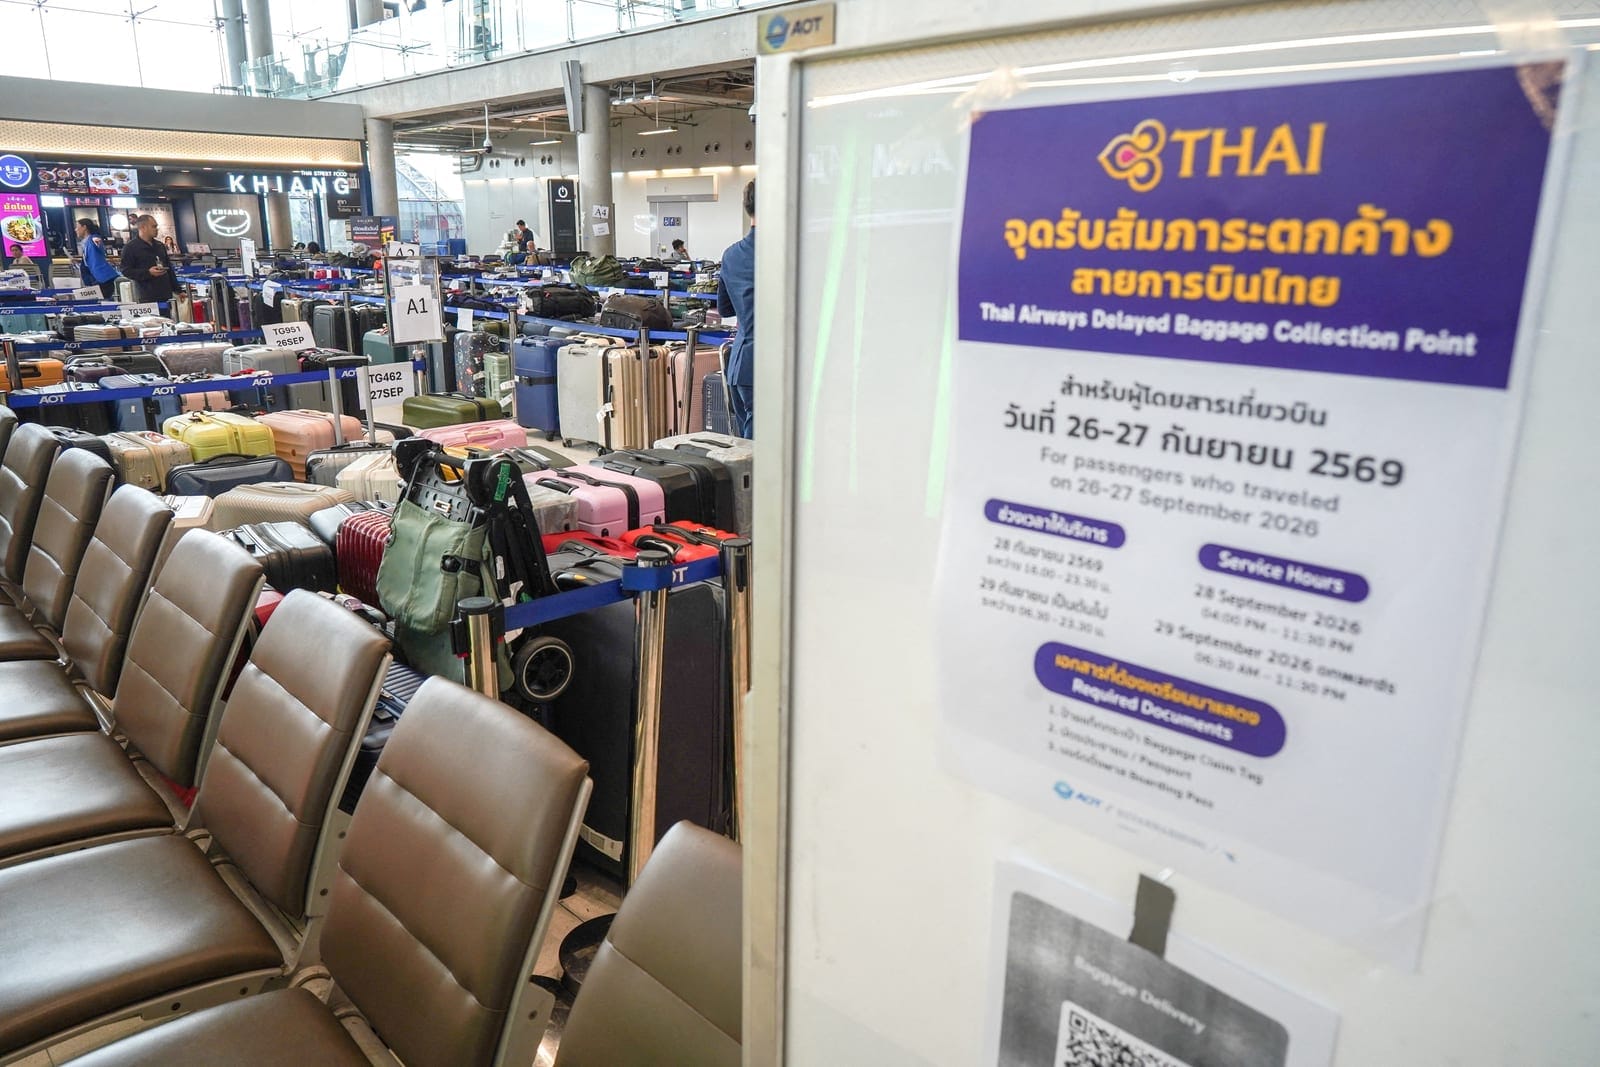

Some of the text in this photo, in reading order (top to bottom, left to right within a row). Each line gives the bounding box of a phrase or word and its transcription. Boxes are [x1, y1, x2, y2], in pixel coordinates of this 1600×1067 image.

[791, 16, 823, 36] AOT
[1169, 122, 1327, 179] THAI
[229, 174, 350, 194] KHIANG
[212, 208, 245, 216] KHIANG
[1004, 204, 1453, 260] จุดรับสัมภาระตกค้าง
[407, 298, 428, 315] A1
[1070, 265, 1340, 307] สายการบินไทย
[272, 326, 301, 336] TG951
[276, 336, 305, 347] 26SEP
[980, 302, 1478, 357] Thai Airways Delayed Baggage Collection Point
[152, 386, 177, 395] AOT
[252, 377, 274, 386] AOT
[341, 369, 356, 378] AO
[369, 371, 402, 384] TG462
[370, 386, 404, 400] 27SEP
[39, 394, 66, 404] AOT
[1060, 375, 1327, 428] สำหรับผู้โดยสารเที่ยวบิน
[1004, 401, 1405, 488] วันที่ 26-27 กันยายน 2569
[1040, 446, 1341, 513] For passengers who traveled
[1050, 477, 1320, 538] on 26-27 September 2026
[1217, 549, 1345, 594] Service Hours
[1194, 583, 1362, 635] 28 September 2026
[1155, 619, 1174, 636] 29
[1178, 625, 1262, 659] September
[1267, 650, 1313, 673] 2026
[1072, 677, 1234, 741] Required Documents
[1139, 989, 1206, 1034] Delivery
